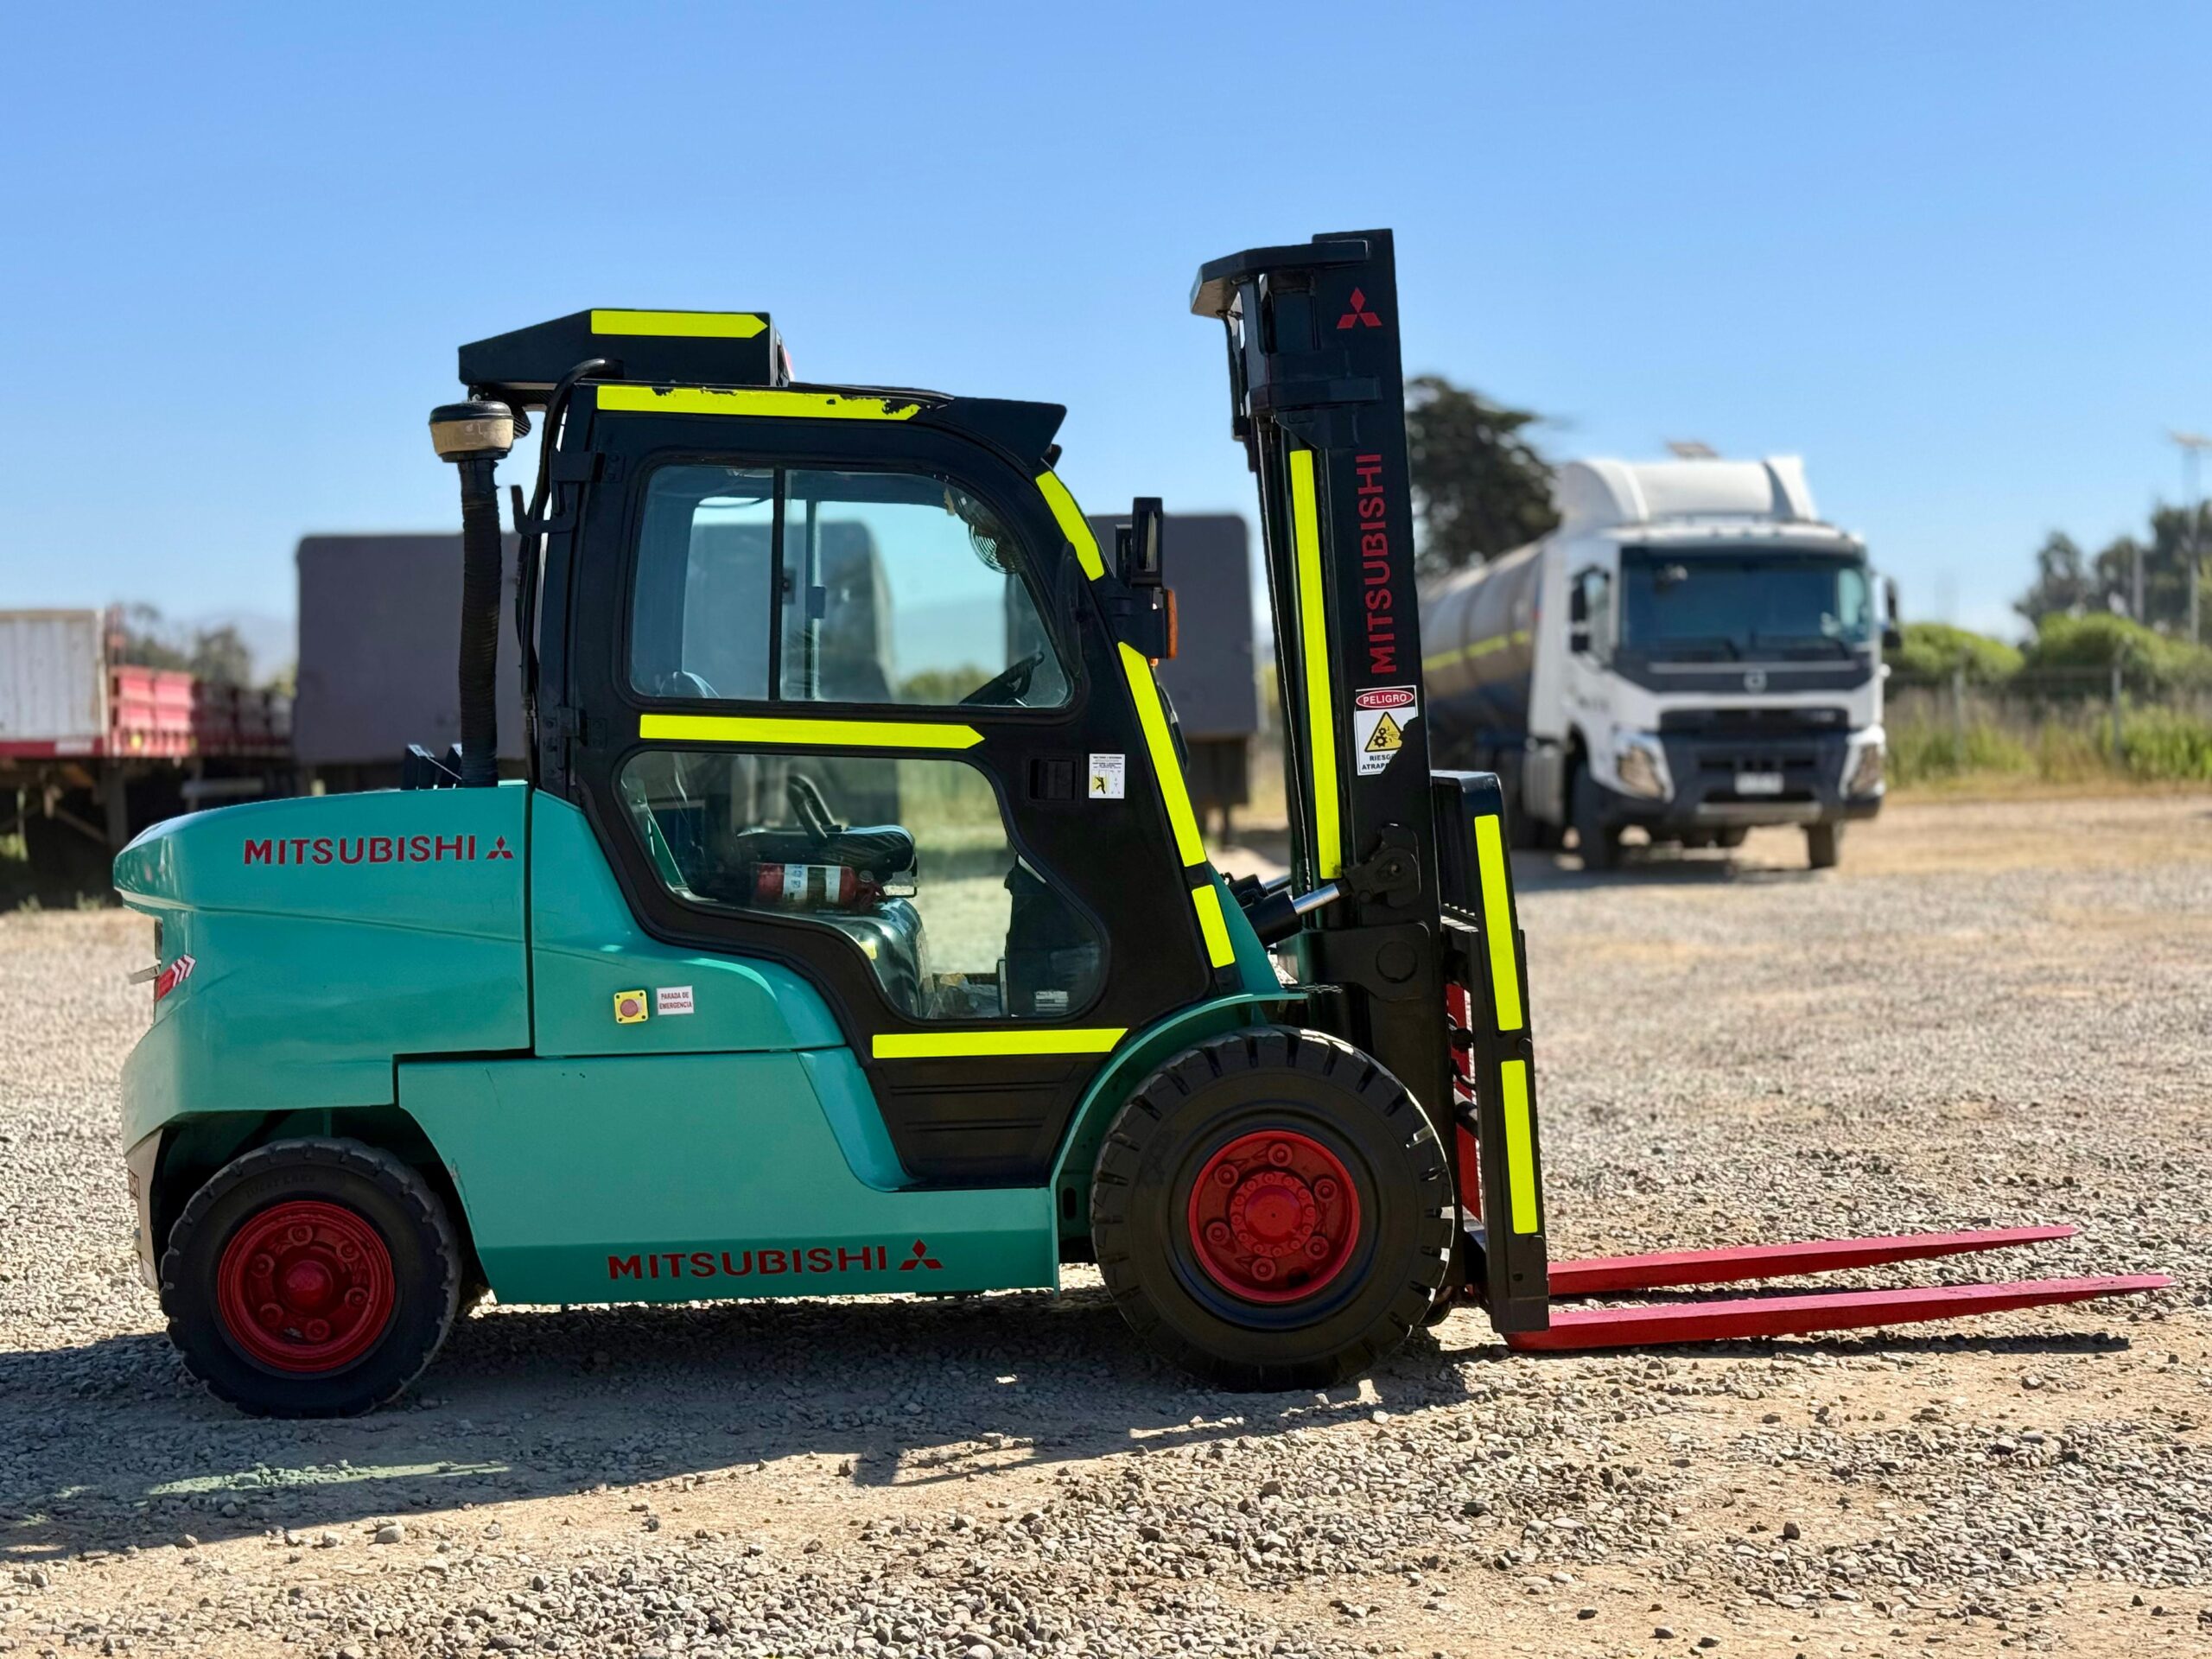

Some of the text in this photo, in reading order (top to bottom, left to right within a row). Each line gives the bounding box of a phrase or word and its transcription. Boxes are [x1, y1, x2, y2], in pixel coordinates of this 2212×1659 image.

[1356, 454, 1398, 673] MITSUBISHI
[1363, 694, 1408, 704] PELIGRO
[244, 836, 475, 864] MITSUBISHI
[608, 1247, 886, 1280] MITSUBISHI
